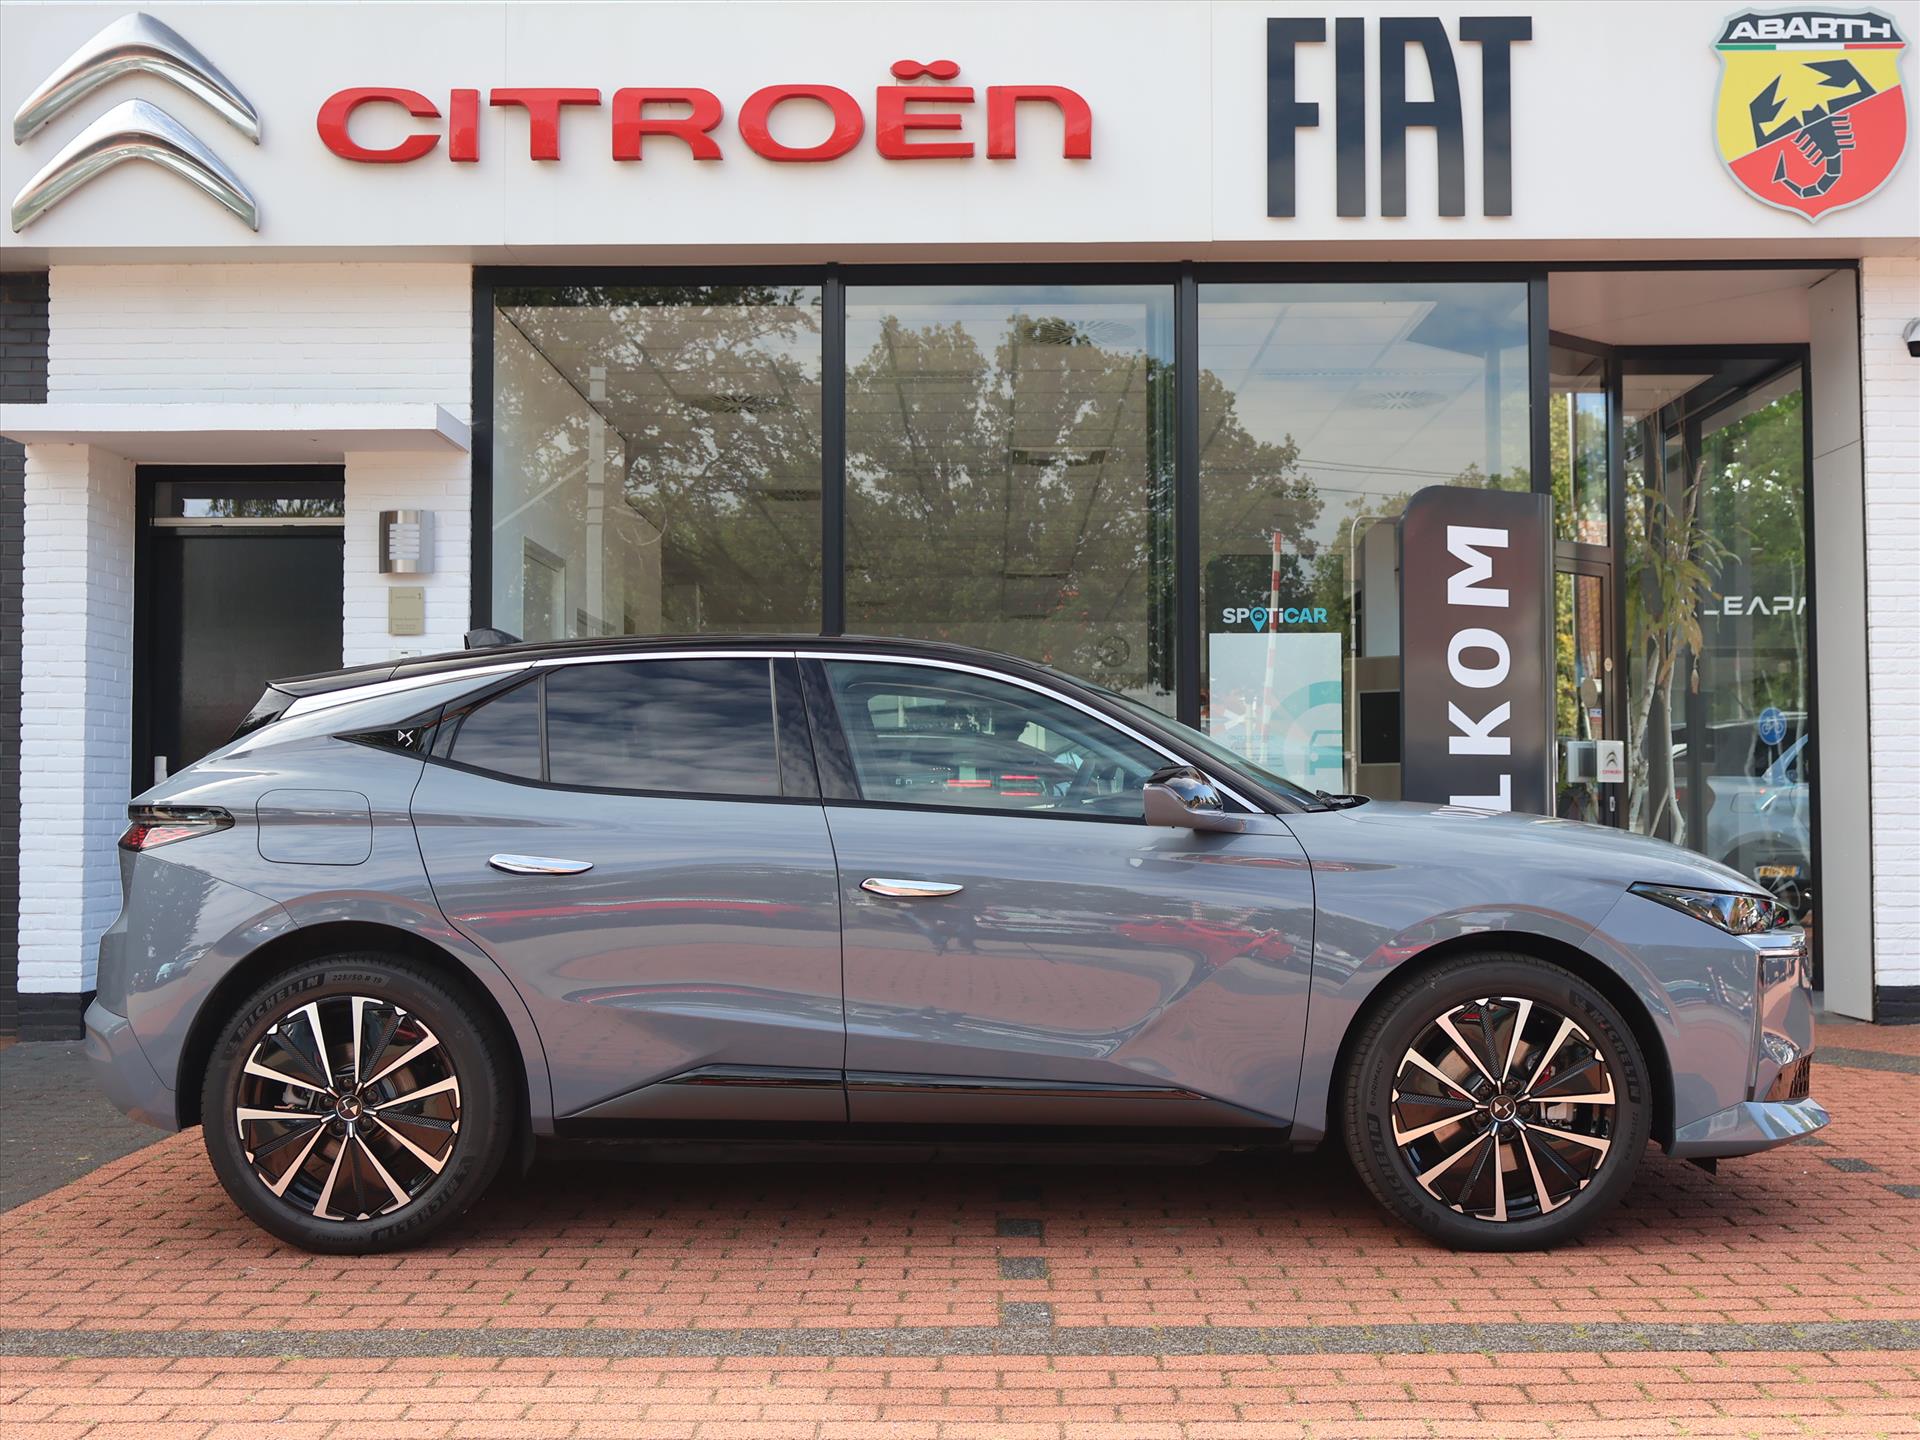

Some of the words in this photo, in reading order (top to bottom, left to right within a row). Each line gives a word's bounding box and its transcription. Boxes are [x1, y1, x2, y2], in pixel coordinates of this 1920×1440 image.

[1728, 17, 1891, 40] ABARTH
[316, 59, 1092, 164] CITROËN
[1267, 16, 1532, 218] FIAT
[236, 975, 320, 1037] MICHELIN
[1588, 1009, 1642, 1098] MICHELIN
